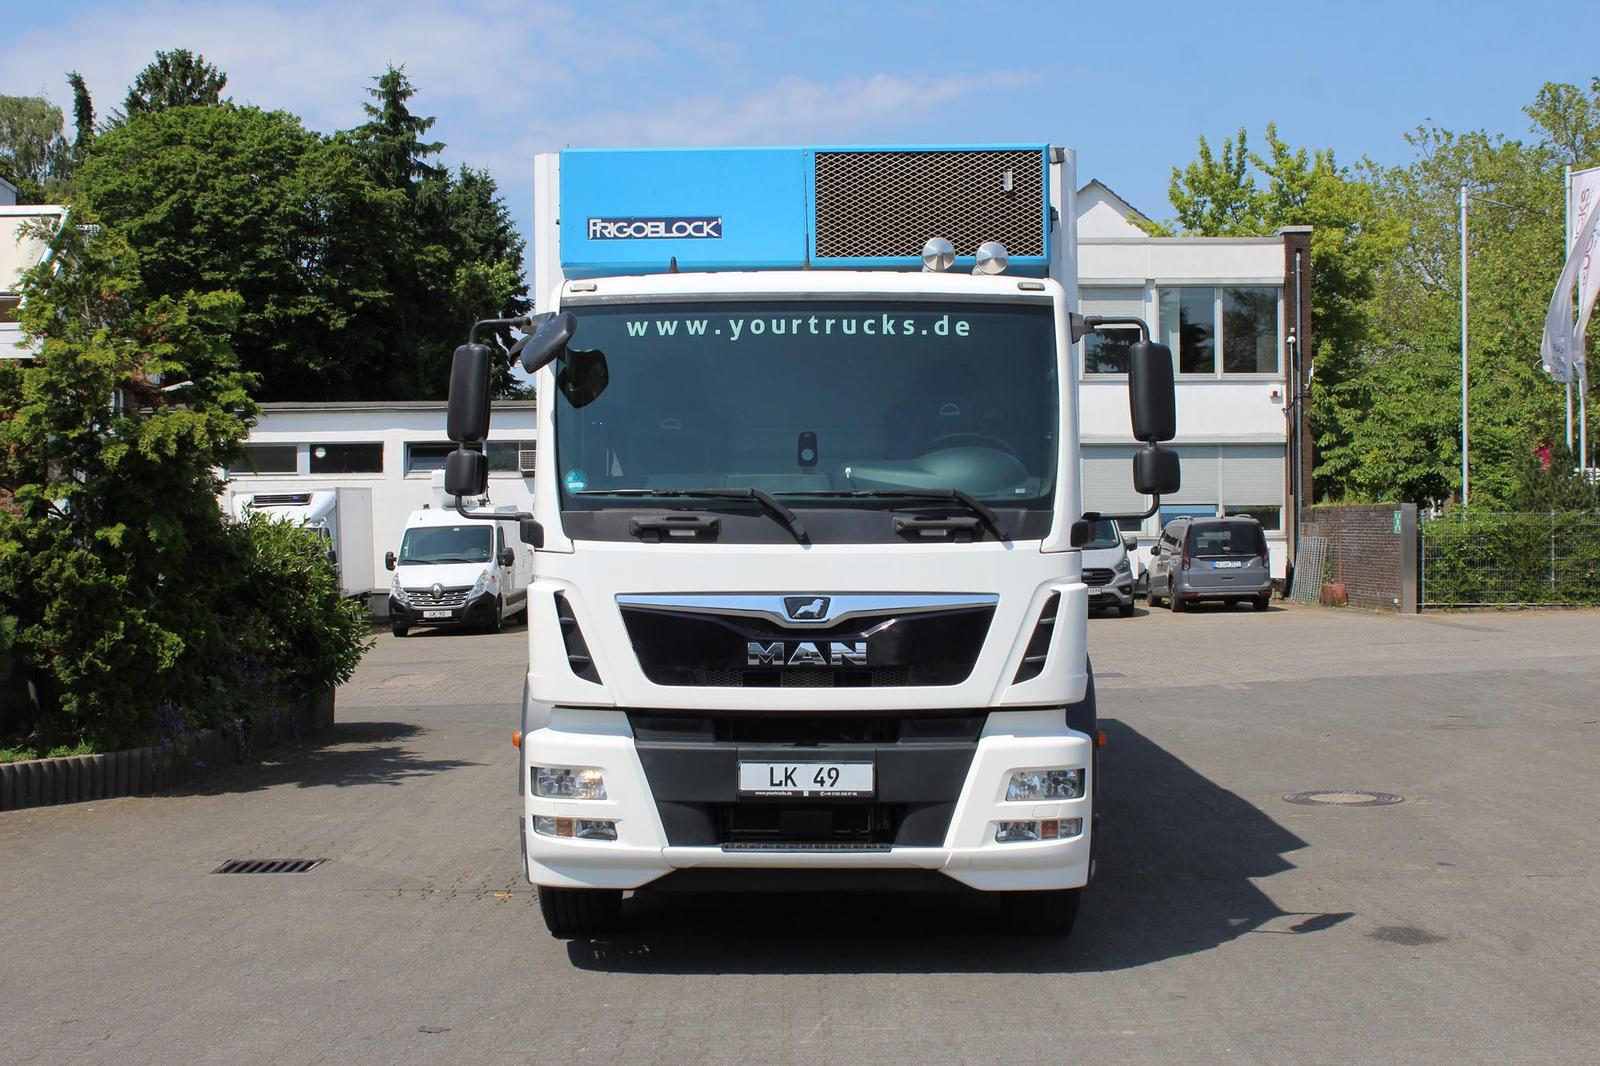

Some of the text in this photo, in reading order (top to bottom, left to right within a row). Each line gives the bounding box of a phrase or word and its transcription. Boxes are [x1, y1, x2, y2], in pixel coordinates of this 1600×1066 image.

[589, 217, 721, 239] FRIGOBLOCK
[626, 314, 970, 341] www.yourtrucks.de
[747, 642, 867, 665] MAN
[769, 766, 840, 787] LK 49
